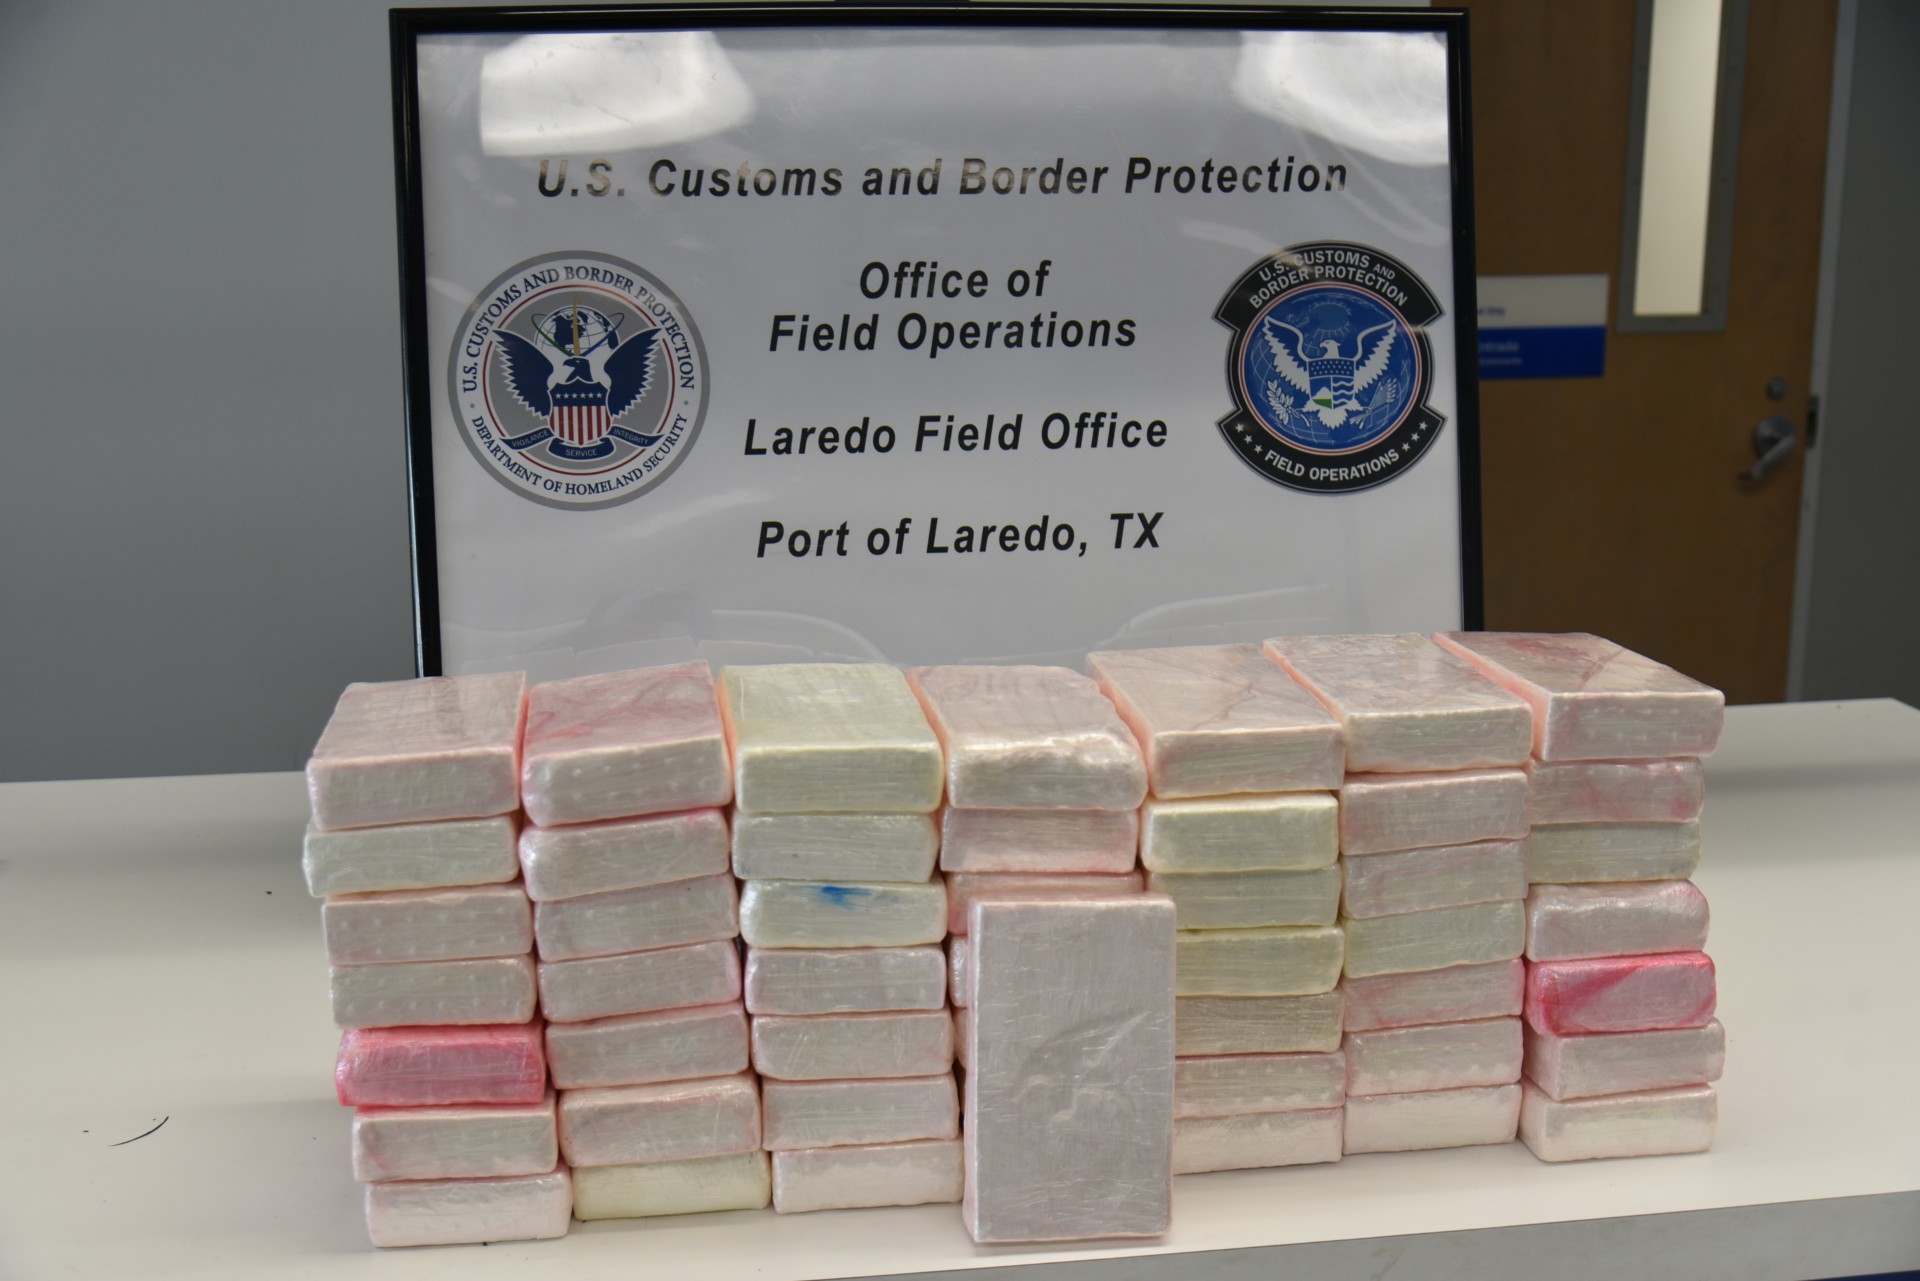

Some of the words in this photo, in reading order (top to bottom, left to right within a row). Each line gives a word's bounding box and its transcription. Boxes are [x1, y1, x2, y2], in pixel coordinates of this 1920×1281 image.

[538, 162, 625, 199] U.S.
[649, 159, 844, 199] Customs
[861, 159, 945, 197] and
[959, 158, 1111, 197] Border
[1125, 156, 1349, 195] Protection
[523, 267, 560, 293] AND
[564, 265, 634, 294] BORDER
[860, 261, 990, 301] Office
[1008, 260, 1054, 299] of
[1259, 260, 1290, 282] U.S.
[1294, 250, 1370, 269] CUSTOMS
[1373, 263, 1396, 280] AND
[1250, 269, 1310, 309] BORDER
[1314, 265, 1408, 307] PROTECTION
[466, 284, 522, 359] CUSTOMS
[634, 286, 695, 390] PROTECTION
[770, 314, 881, 353] Field
[898, 310, 1138, 361] Operations
[463, 362, 478, 393] U.S.
[472, 416, 542, 486] DEPARTMENT
[543, 478, 563, 493] OF
[565, 467, 644, 496] HOMELAND
[643, 413, 688, 473] SECURITY
[511, 429, 550, 448] VIGILANCE
[565, 448, 598, 457] SERVICE
[613, 428, 650, 445] INTEGRITY
[744, 417, 897, 457] Laredo
[915, 414, 1025, 454] Field
[1041, 412, 1169, 451] Office
[1264, 450, 1305, 477] FIELD
[1309, 448, 1400, 482] OPERATIONS
[757, 521, 851, 561] Port
[867, 518, 914, 558] of
[926, 515, 1089, 560] Laredo,
[1110, 512, 1167, 551] TX
